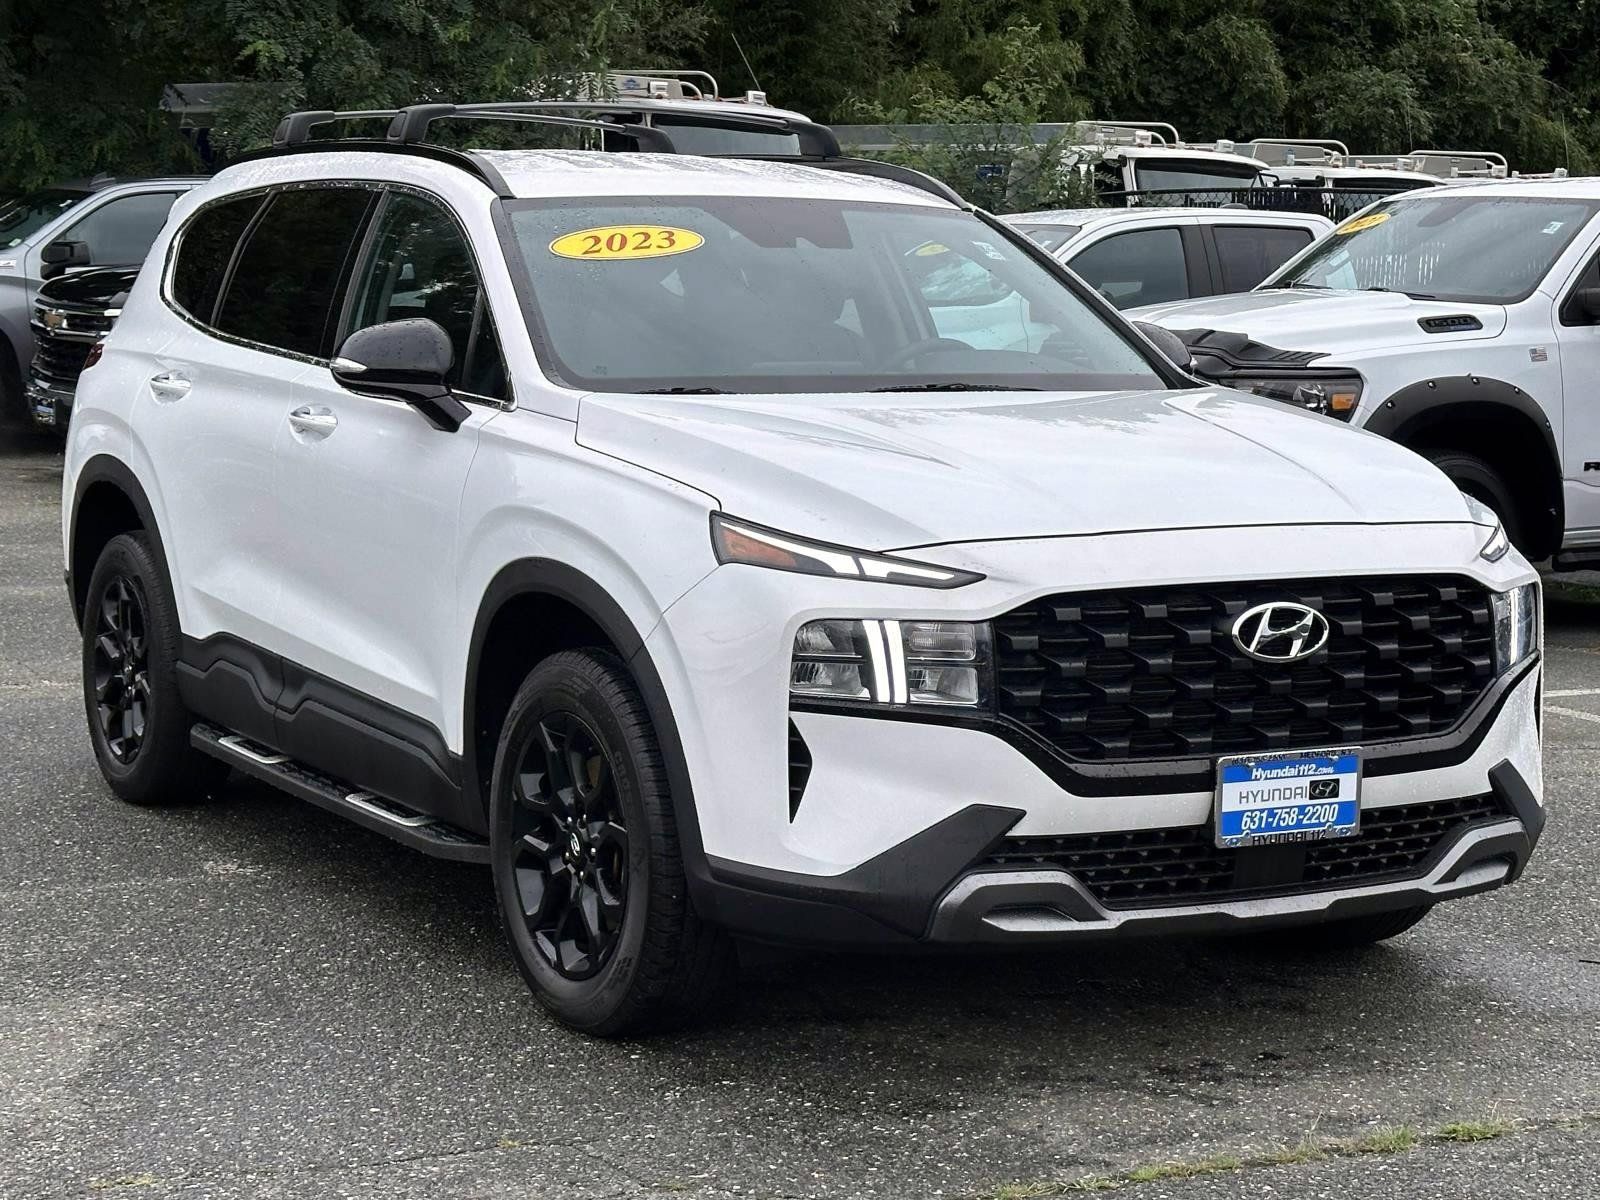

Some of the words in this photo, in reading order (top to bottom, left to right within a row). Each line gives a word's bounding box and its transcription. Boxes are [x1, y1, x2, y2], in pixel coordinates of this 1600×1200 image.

[581, 230, 677, 255] 2023
[1251, 763, 1335, 781] Hyundai112.com
[1239, 785, 1308, 805] HYUNDAI
[1241, 803, 1339, 830] 631-758-2200
[1252, 831, 1307, 846] HYUNDAI
[1310, 828, 1327, 841] 112
